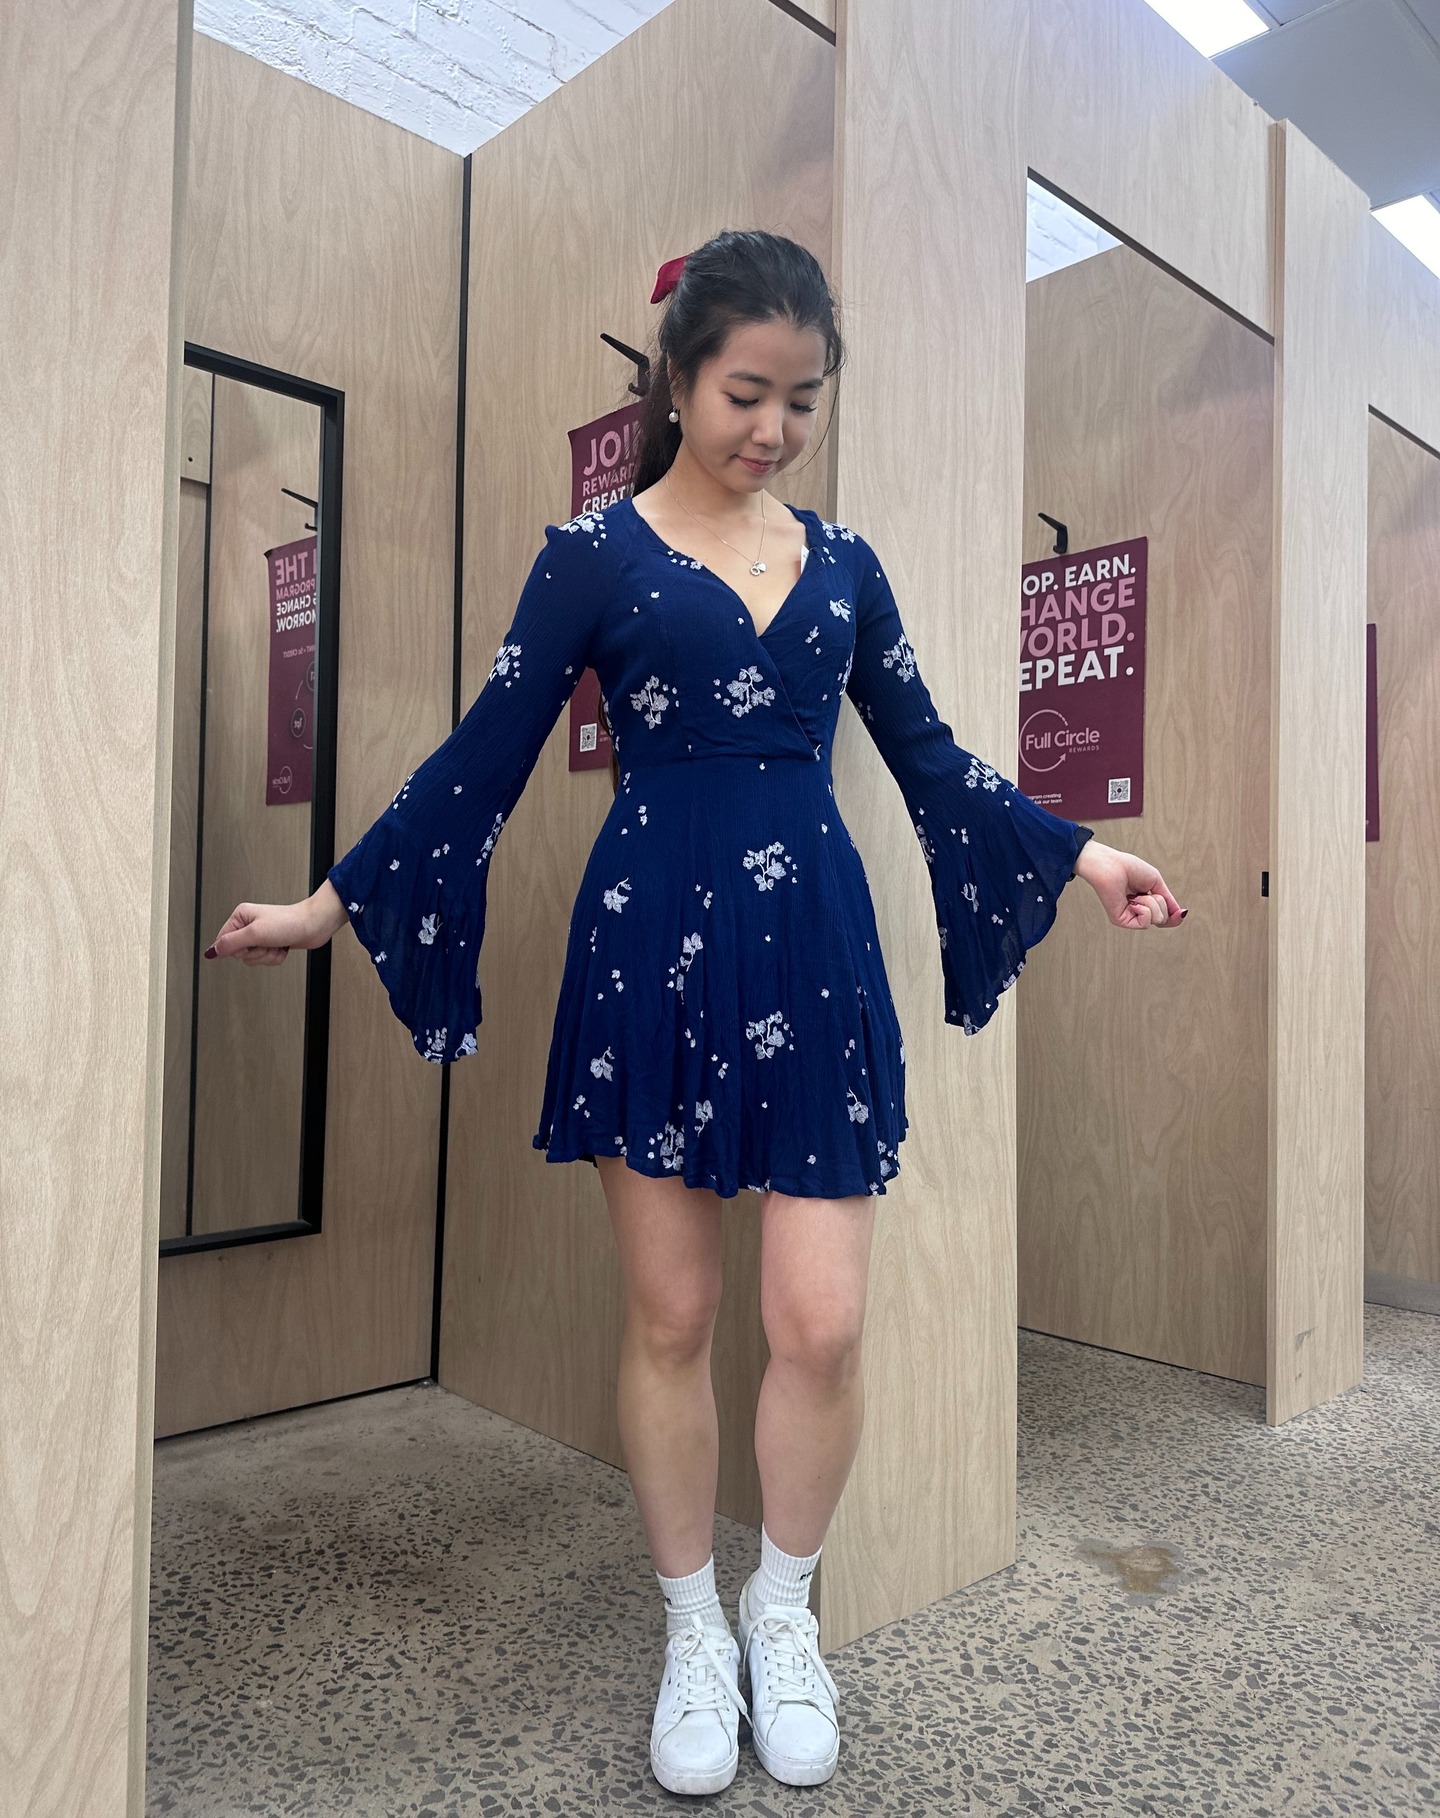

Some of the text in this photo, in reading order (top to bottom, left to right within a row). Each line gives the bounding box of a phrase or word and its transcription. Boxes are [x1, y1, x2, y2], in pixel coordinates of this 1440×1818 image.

[1065, 554, 1136, 588] EARN.
[1020, 645, 1134, 692] EPEAT.
[1025, 727, 1100, 750] Full Circle
